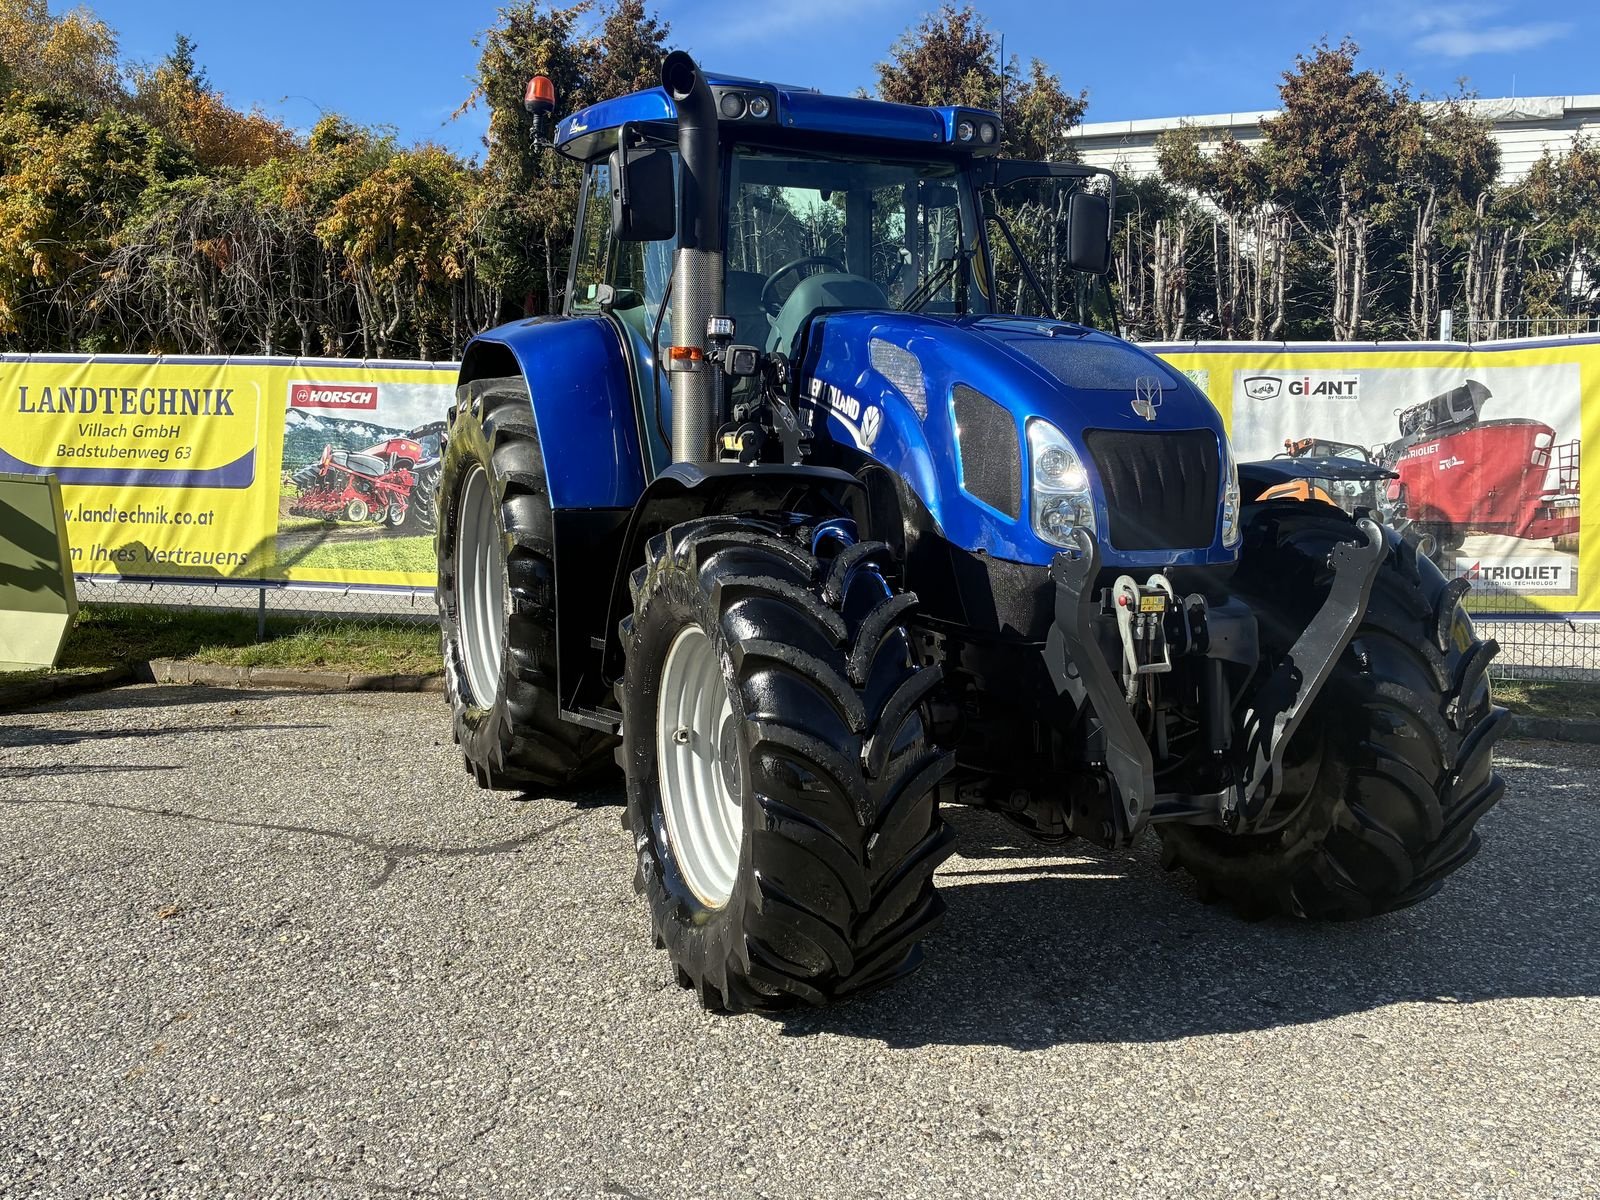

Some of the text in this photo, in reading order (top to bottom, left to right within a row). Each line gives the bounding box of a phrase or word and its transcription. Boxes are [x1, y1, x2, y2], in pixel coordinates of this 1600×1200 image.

[18, 386, 234, 416] LANDTECHNIK
[309, 390, 372, 404] HORSCH
[78, 423, 181, 439] Villach GmbH
[56, 444, 192, 463] Badstubenweg 63
[90, 544, 137, 562] Ihres
[144, 545, 249, 566] Vertrauens
[1481, 566, 1562, 580] TRIOLIET
